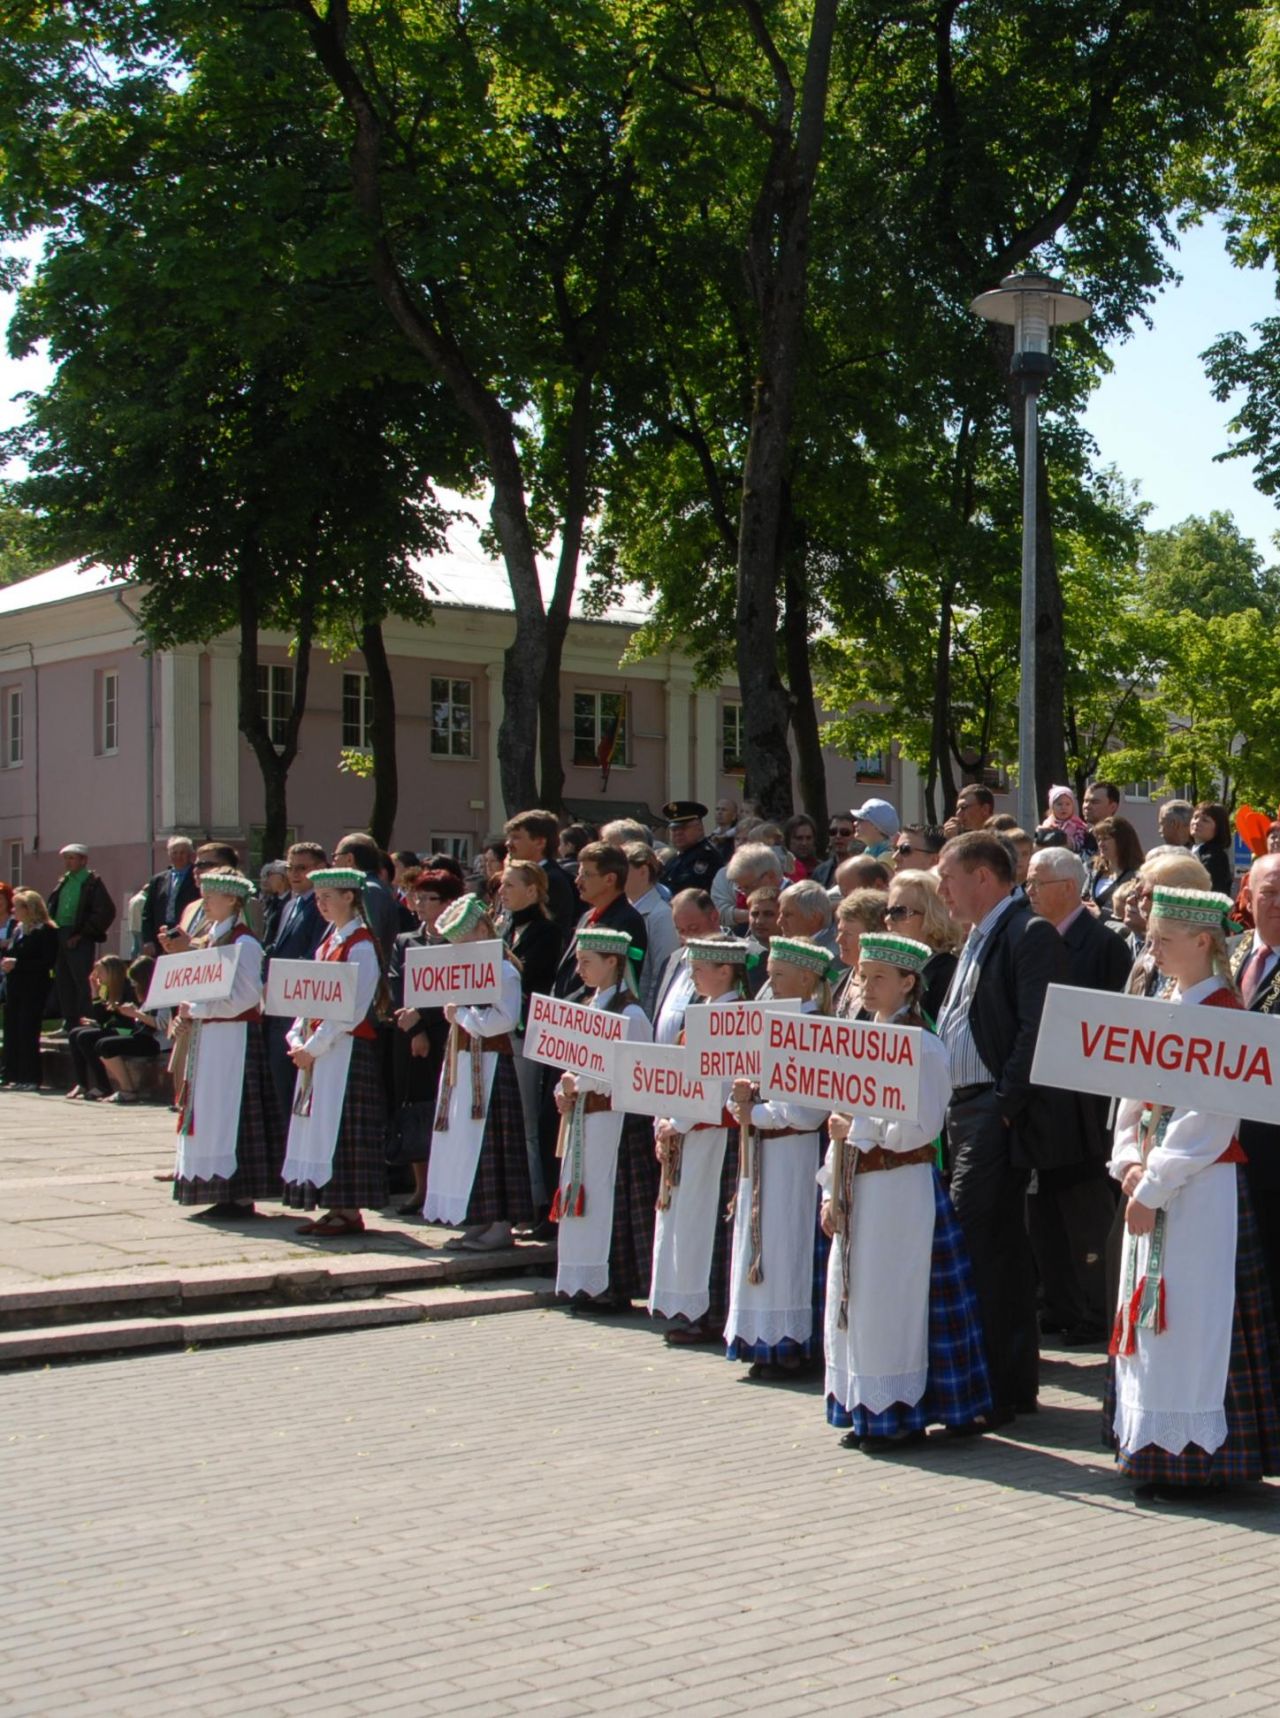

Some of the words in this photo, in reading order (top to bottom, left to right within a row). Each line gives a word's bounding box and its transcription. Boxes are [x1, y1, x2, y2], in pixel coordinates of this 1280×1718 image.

[164, 962, 223, 990] UKRAINA
[284, 978, 342, 1002] LATVIJA
[412, 962, 497, 993] VOKIETIJA
[533, 998, 623, 1041] BALTARUSIJA
[709, 1004, 763, 1036] DIDŽIO
[536, 1028, 589, 1068] ŽODINO
[590, 1051, 605, 1074] m.
[769, 1018, 914, 1067] BALTARUSIJA
[1080, 1021, 1273, 1086] VENGRIJA
[631, 1060, 705, 1101] ŠVEDIJA
[769, 1056, 877, 1107] AŠMENOS
[882, 1085, 907, 1112] m.
